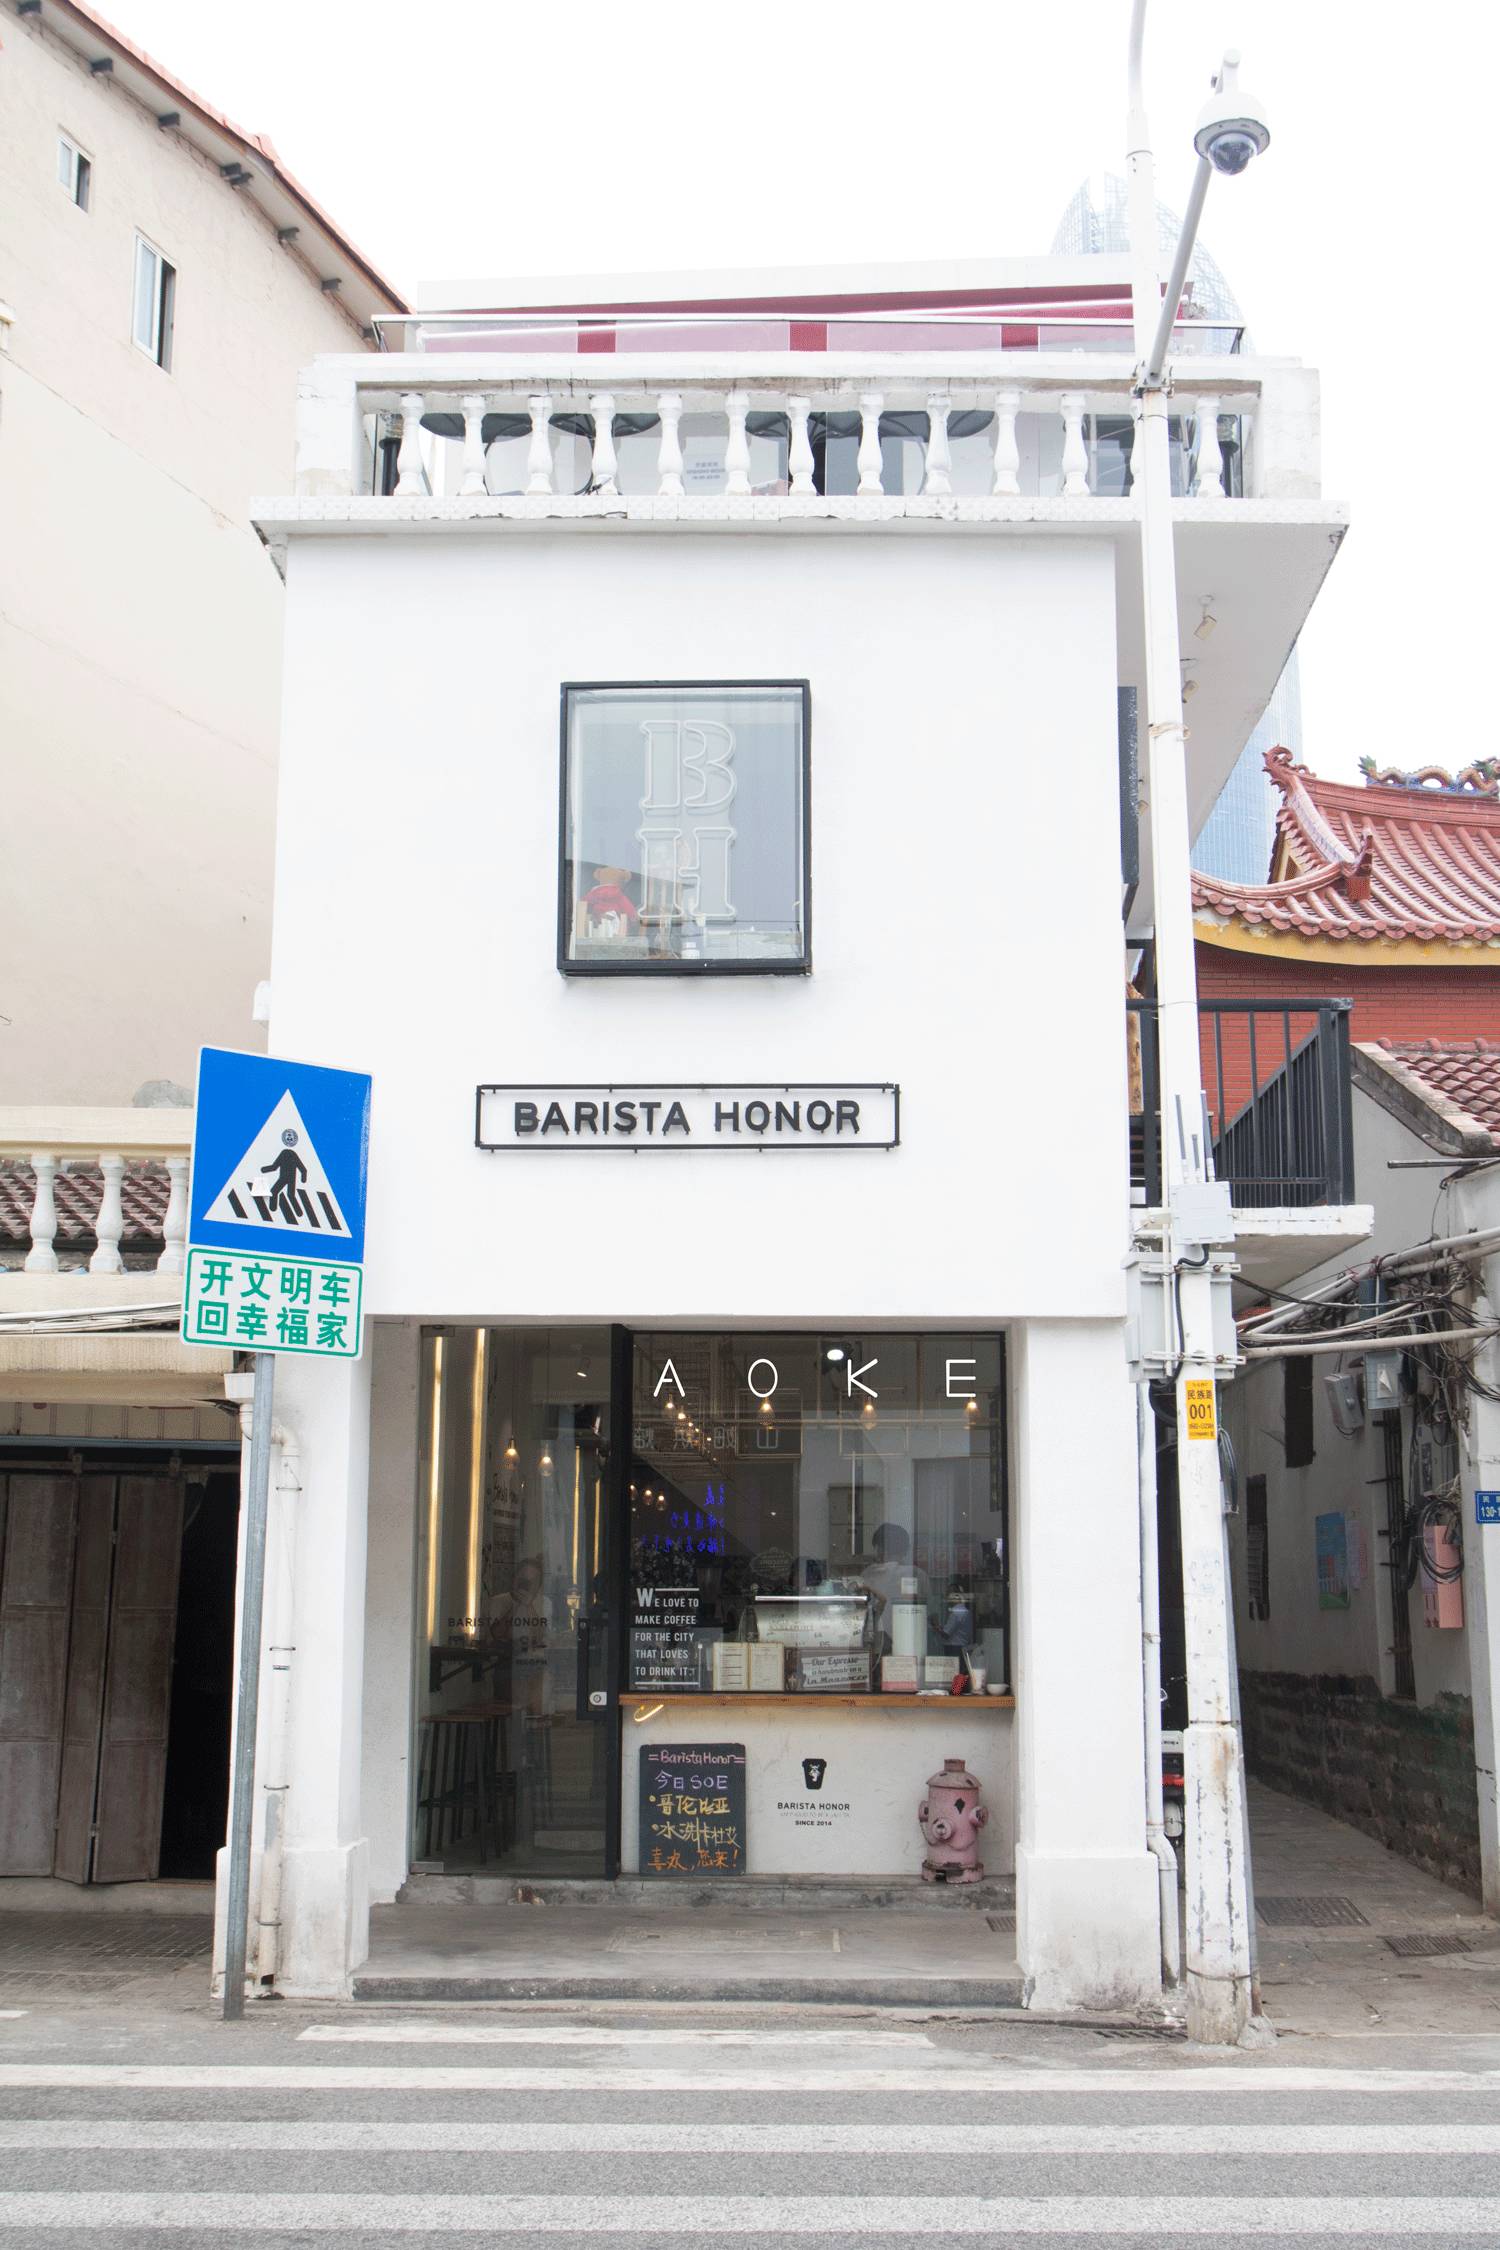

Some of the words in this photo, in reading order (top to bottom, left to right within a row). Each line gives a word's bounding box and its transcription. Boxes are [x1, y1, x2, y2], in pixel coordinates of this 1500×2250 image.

[639, 720, 736, 808] B
[514, 1101, 690, 1135] BARISTA
[714, 1100, 860, 1134] HONOR
[200, 1259, 350, 1308] 开文明车
[196, 1299, 348, 1349] 回幸福家
[1189, 1404, 1212, 1419] 001
[663, 1598, 686, 1607] LOVE
[688, 1598, 699, 1607] TO
[448, 1617, 499, 1627] BARISTA
[505, 1617, 548, 1627] HONOR
[635, 1615, 661, 1624] MAKE
[664, 1615, 696, 1624] COFFEE
[635, 1632, 652, 1641] FOR
[655, 1632, 671, 1641] THE
[674, 1632, 695, 1641] CITY
[635, 1650, 657, 1659] THAT
[660, 1650, 688, 1659] LOVES
[635, 1667, 646, 1676] TO
[649, 1667, 676, 1676] DRINK
[661, 1750, 702, 1766] Barista
[703, 1752, 735, 1764] Honor
[654, 1769, 684, 1790] 今日
[690, 1774, 728, 1790] SOE
[777, 1802, 816, 1810] BARISTA
[819, 1803, 850, 1811] HONOR
